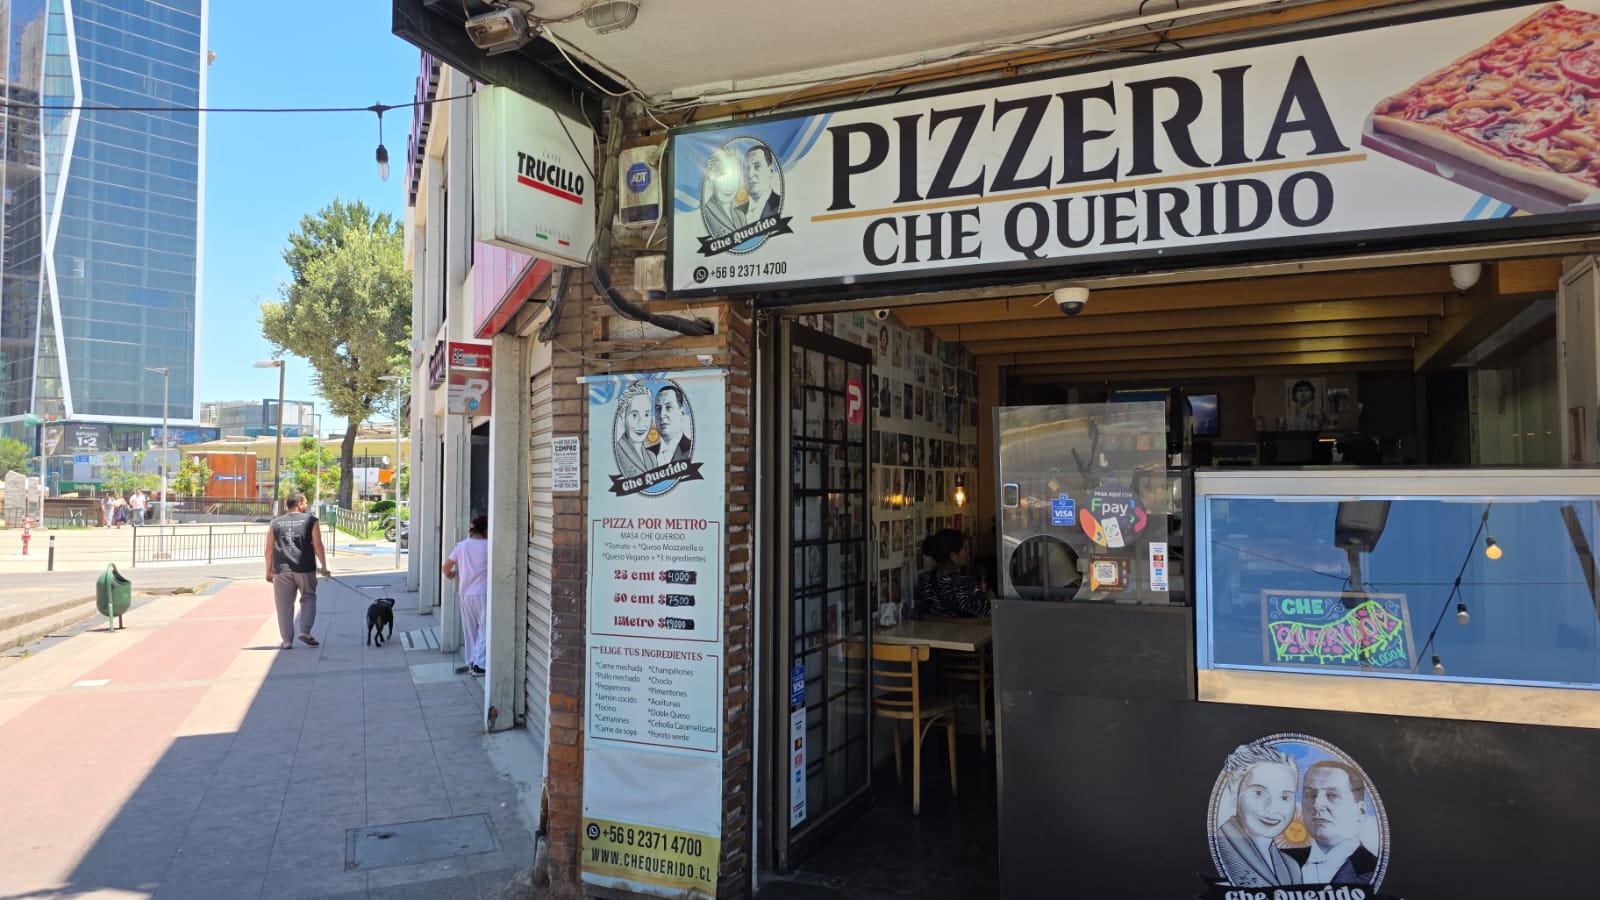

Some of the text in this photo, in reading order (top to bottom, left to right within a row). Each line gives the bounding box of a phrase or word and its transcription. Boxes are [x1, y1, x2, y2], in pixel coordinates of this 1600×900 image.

[827, 55, 1350, 211] PIZZERIA
[518, 152, 584, 195] TRUCILLO
[632, 172, 647, 184] ADT
[862, 171, 1335, 266] CHE QUERIDO
[710, 218, 776, 251] Che Querido
[711, 261, 786, 278] +56 9 2371 4700
[622, 462, 688, 492] Che Querido
[1092, 498, 1128, 516] Fpay
[602, 518, 707, 530] PIZZA POR METRO
[621, 532, 639, 540] MASA
[655, 533, 685, 541] QUERIDO
[626, 554, 649, 562] Vegano
[666, 554, 706, 562] Ingredientes
[614, 570, 628, 580] 25
[614, 593, 627, 602] 50
[1281, 598, 1324, 615] CHE
[1277, 617, 1377, 647] QUERIDO
[600, 646, 703, 660] ELIGE TUS INGREDIENTES
[616, 664, 642, 672] mechada
[613, 674, 640, 682] mechado
[674, 722, 716, 733] Caramelizada
[602, 826, 702, 857] +56 9 2371 4700
[591, 848, 711, 882] WWW.CHEQUERIDO.CL
